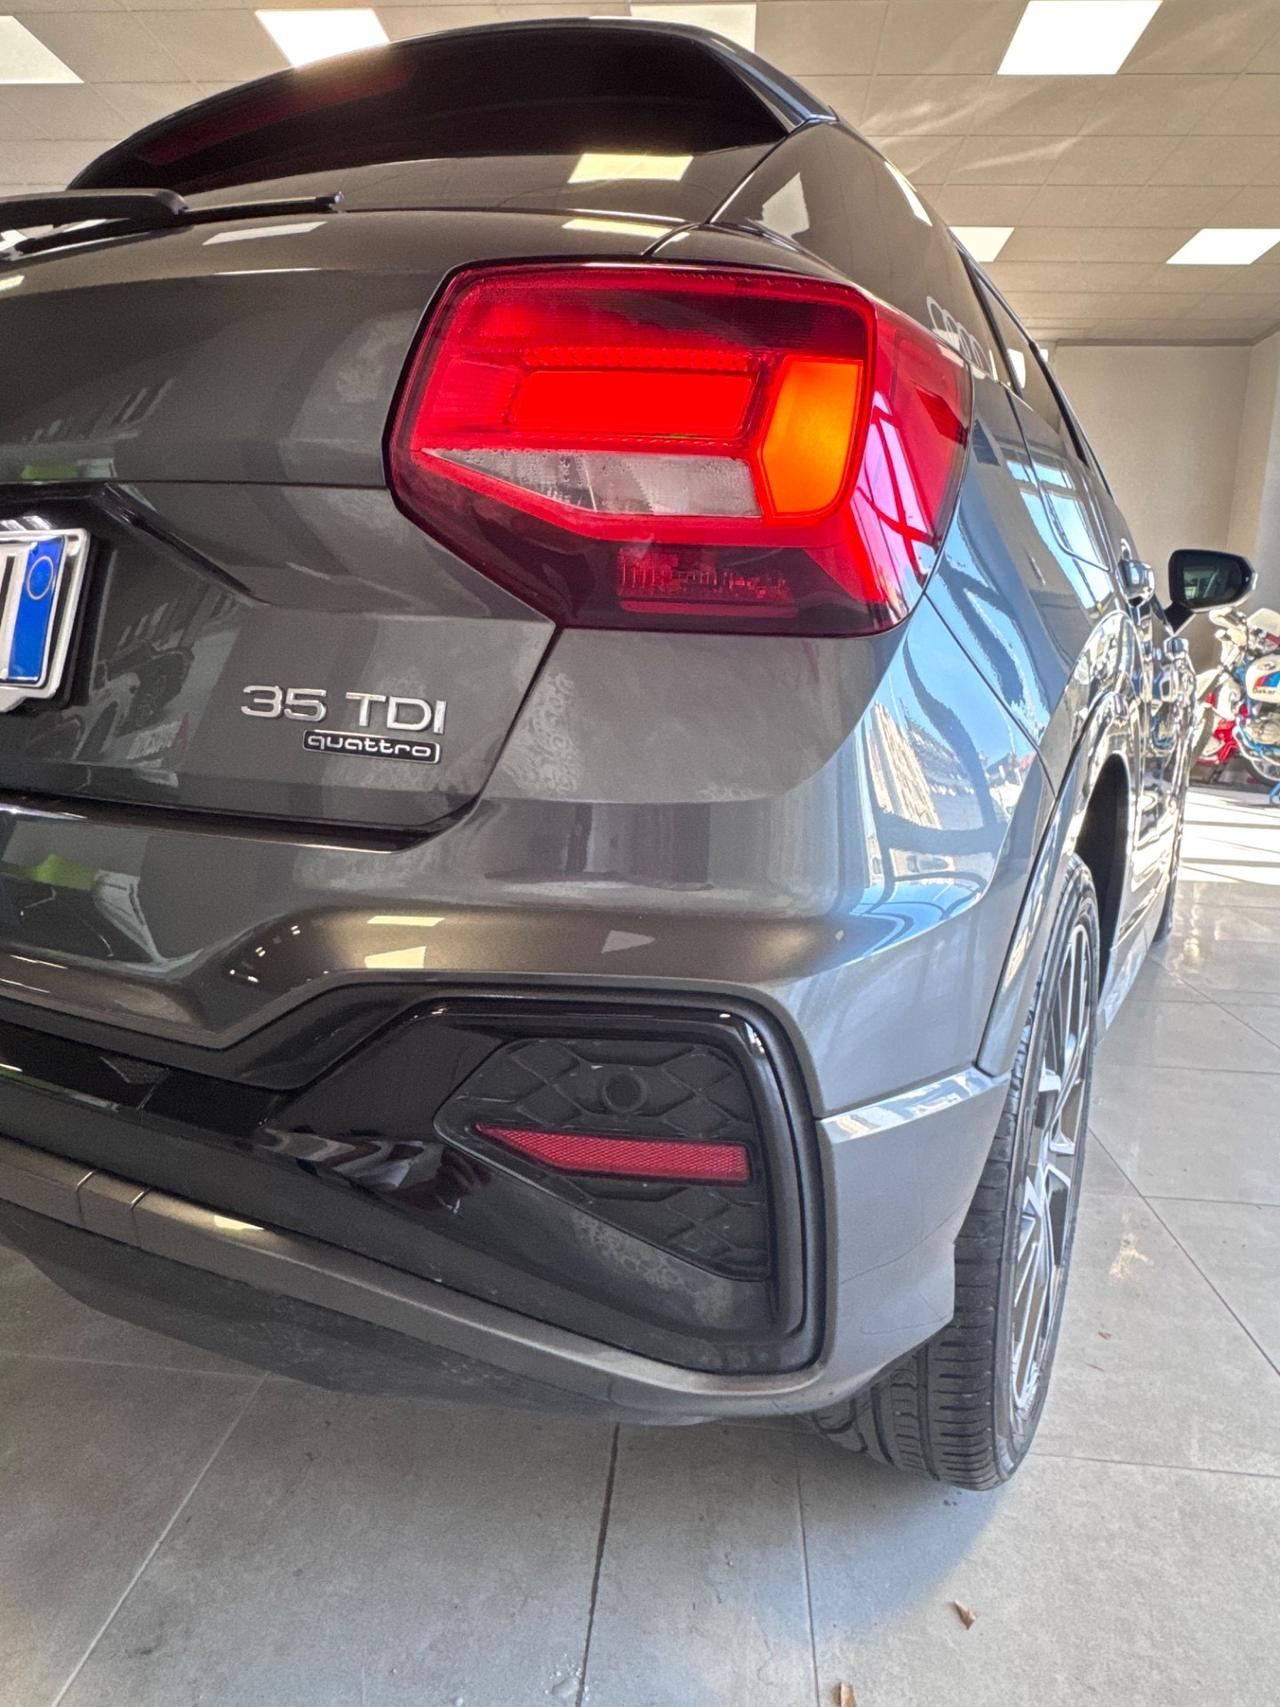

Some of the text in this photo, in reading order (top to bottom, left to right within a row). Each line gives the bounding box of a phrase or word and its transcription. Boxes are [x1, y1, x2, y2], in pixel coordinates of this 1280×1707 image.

[241, 685, 447, 735] 35 TDI
[307, 734, 432, 758] quattro
